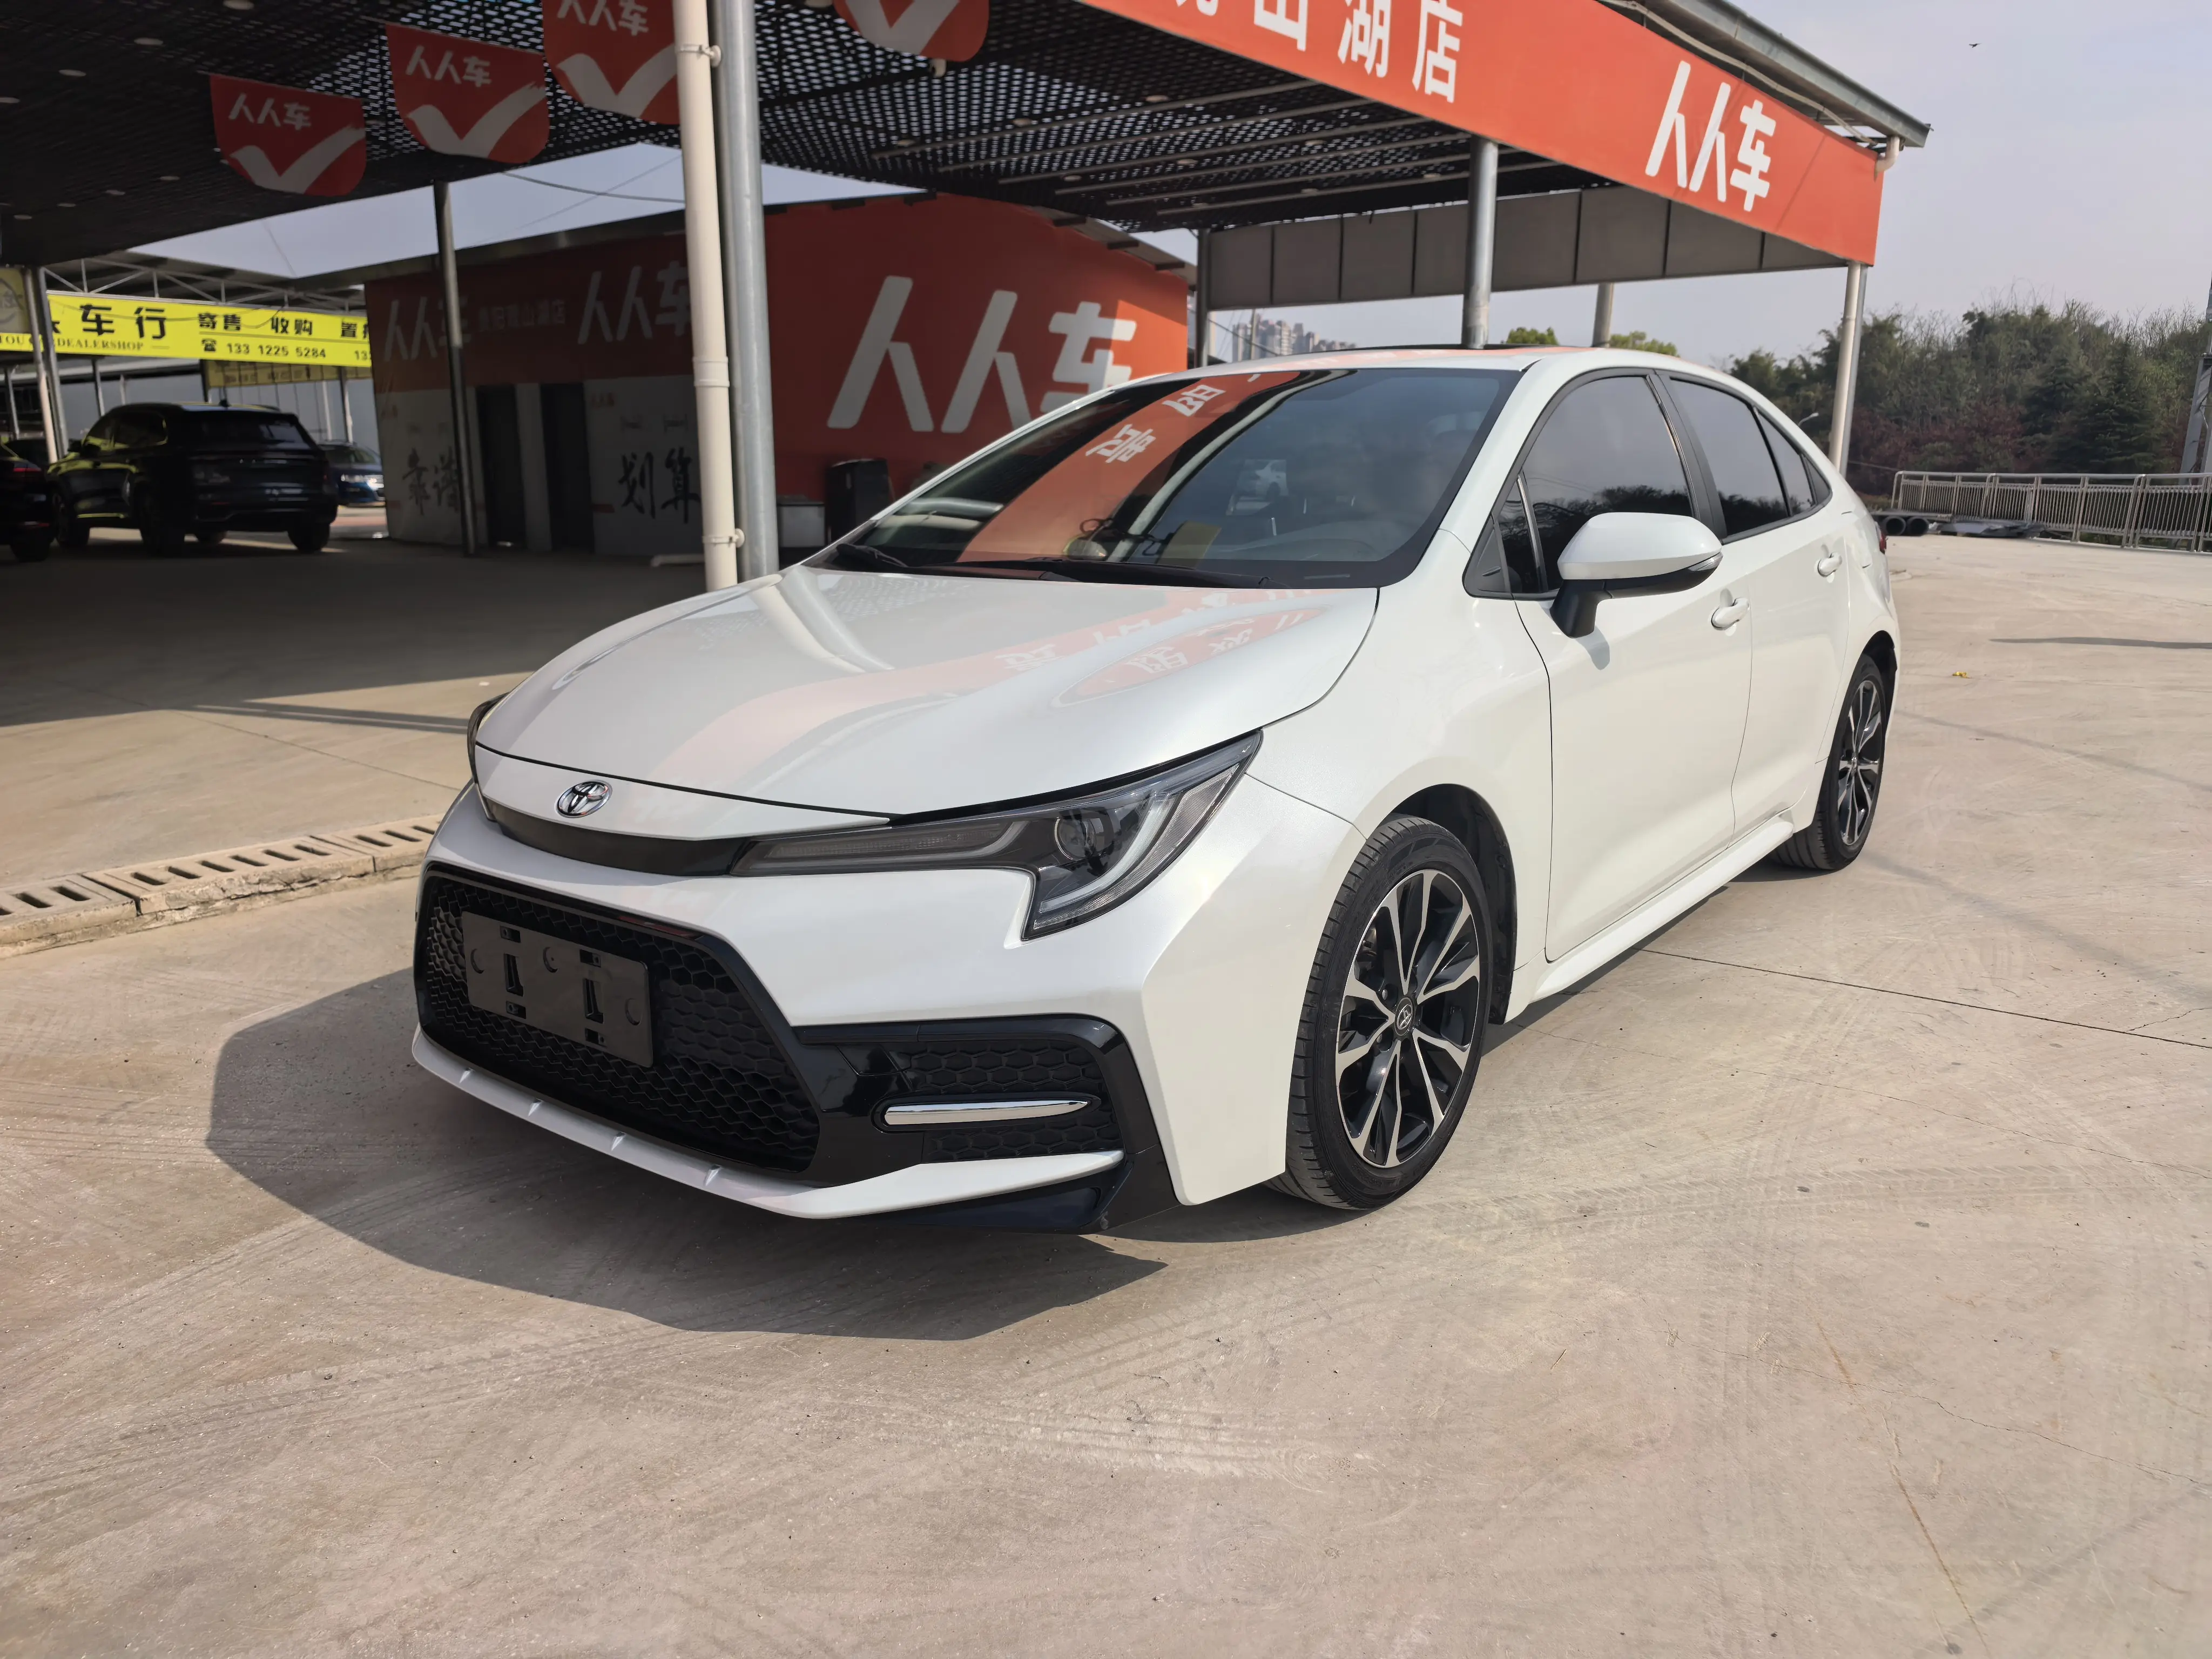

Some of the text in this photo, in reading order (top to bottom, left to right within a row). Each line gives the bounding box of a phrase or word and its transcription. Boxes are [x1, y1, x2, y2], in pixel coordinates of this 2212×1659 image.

[556, 0, 649, 36] 人人车
[406, 45, 491, 87] 人人车
[1176, 0, 1463, 103] 山湖店
[228, 93, 312, 131] 人人车
[1645, 60, 1776, 212] 人人车
[577, 260, 692, 345] 人人车
[271, 316, 313, 335] 收购
[227, 343, 372, 361] 133 1225 5284 13
[827, 275, 1137, 434] 人人车
